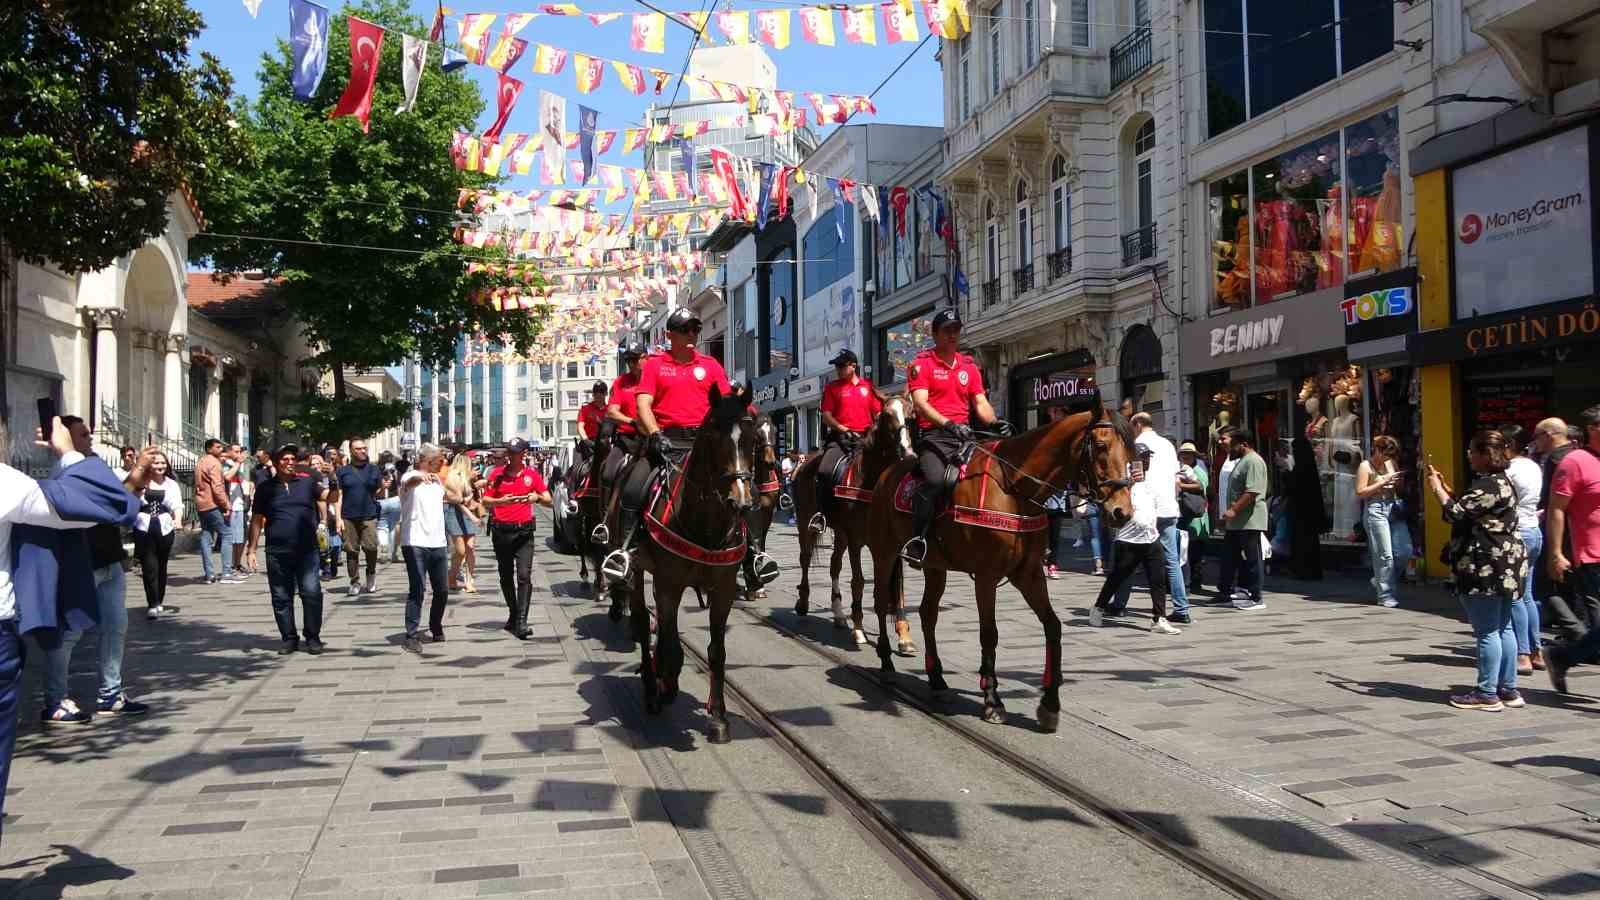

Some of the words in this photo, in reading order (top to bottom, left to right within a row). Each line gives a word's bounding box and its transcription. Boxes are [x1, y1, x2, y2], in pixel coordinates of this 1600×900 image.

[1485, 192, 1582, 230] MoneyGram
[1338, 286, 1413, 325] TOYS
[1210, 315, 1284, 357] BENNY
[1465, 315, 1550, 357] ÇETİN
[1556, 303, 1600, 337] DÖ
